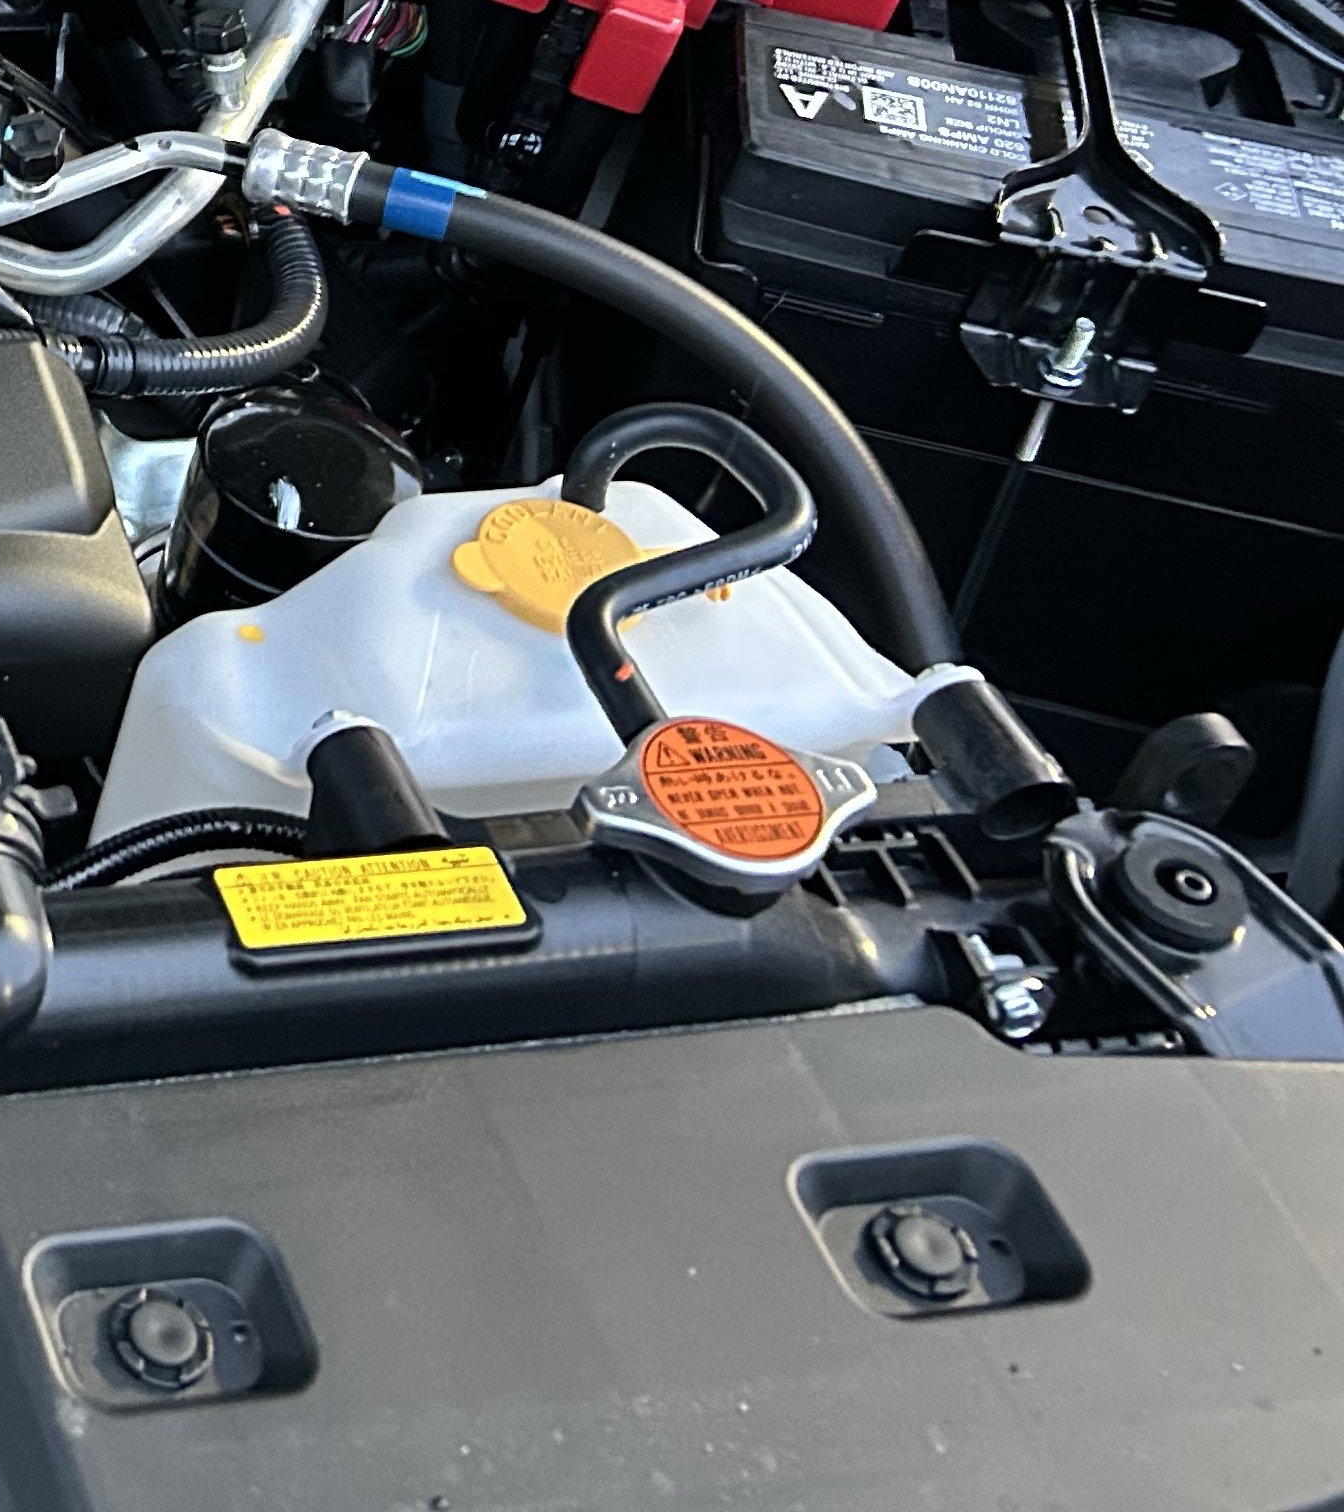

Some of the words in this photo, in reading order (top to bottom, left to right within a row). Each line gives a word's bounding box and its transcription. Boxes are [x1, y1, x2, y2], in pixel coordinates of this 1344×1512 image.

[987, 115, 1019, 128] LN2
[880, 125, 916, 139] AMPS
[938, 126, 989, 144] AMPS
[688, 742, 767, 763] WARNING
